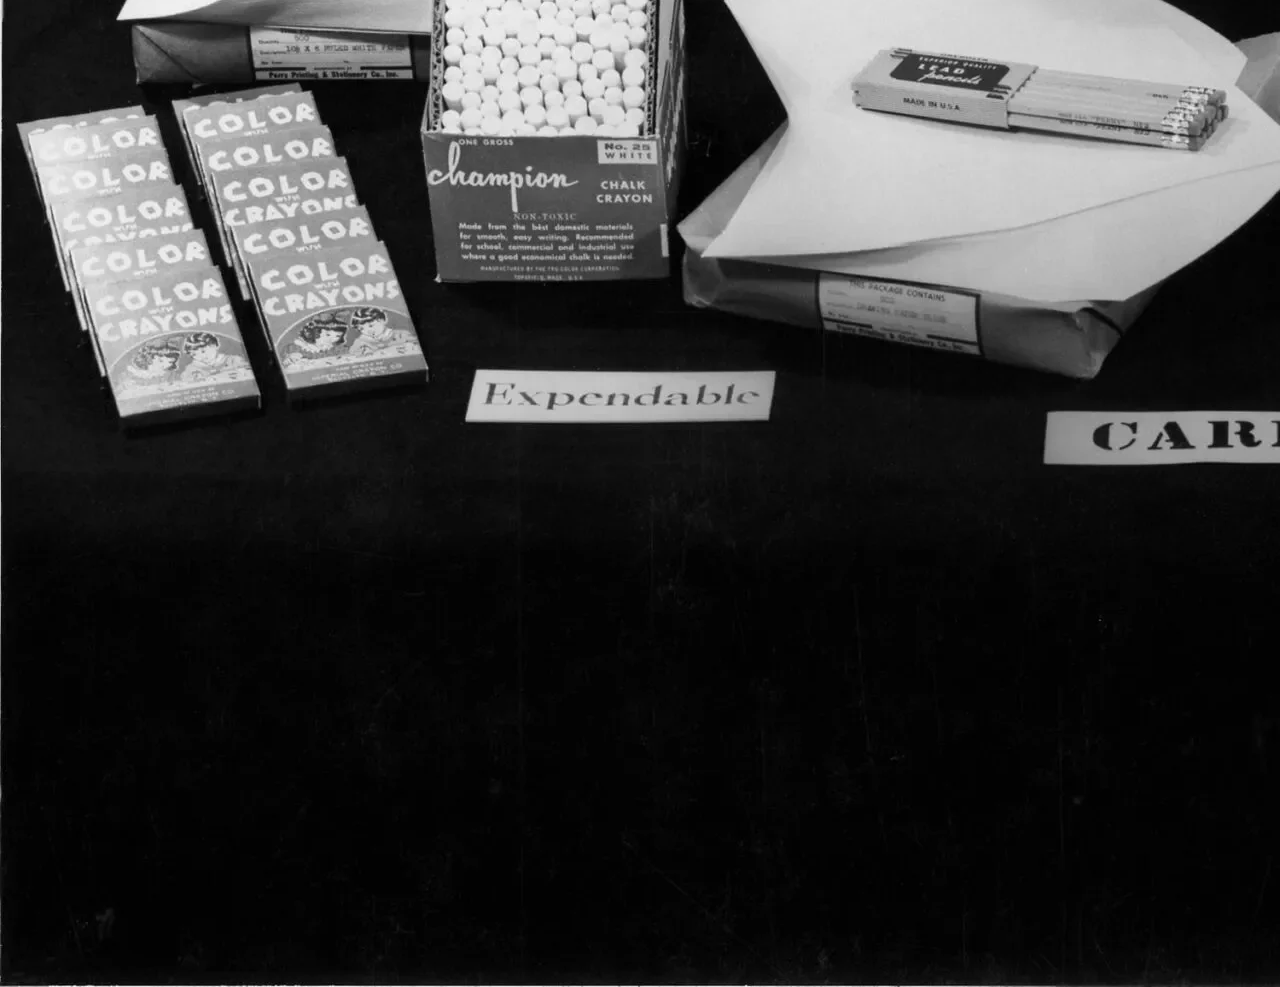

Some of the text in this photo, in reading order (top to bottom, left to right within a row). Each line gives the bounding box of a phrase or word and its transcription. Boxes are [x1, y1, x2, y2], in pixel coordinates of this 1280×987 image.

[918, 63, 965, 74] LEAD
[903, 97, 926, 107] MADE
[928, 100, 938, 108] IN
[194, 102, 315, 139] COLOR
[38, 126, 158, 161] COLOR
[208, 137, 332, 172] COLOR
[458, 138, 514, 146] ONE GROSS
[604, 142, 651, 151] No. 25
[604, 152, 653, 160] WHITE
[48, 160, 170, 196] COLOR
[222, 168, 348, 202] COLOR
[600, 180, 646, 190] CHALK
[596, 194, 653, 204] CRAYON
[63, 197, 186, 232] COLOR
[458, 222, 634, 231] Made from the best domestic materials
[513, 212, 578, 221] NON-TOXIC
[243, 217, 369, 254] COLOR
[459, 232, 472, 241] for
[513, 234, 532, 243] easy
[575, 232, 634, 241] Recommended
[460, 242, 473, 252] for
[508, 242, 554, 252] commercial
[558, 242, 574, 252] and
[578, 242, 616, 252] industrial
[83, 241, 206, 277] COLOR
[461, 252, 486, 261] where
[498, 252, 518, 263] good
[522, 253, 566, 262] economical
[568, 252, 591, 262] chalk
[593, 253, 600, 261] is
[260, 254, 389, 292] COLOR
[96, 278, 224, 316] COLOR
[264, 280, 400, 316] CRAYONS
[868, 280, 902, 295] PACKAGE
[906, 288, 946, 302] CONTAINS
[99, 304, 232, 342] CRAYONS
[482, 382, 760, 411] Expendable
